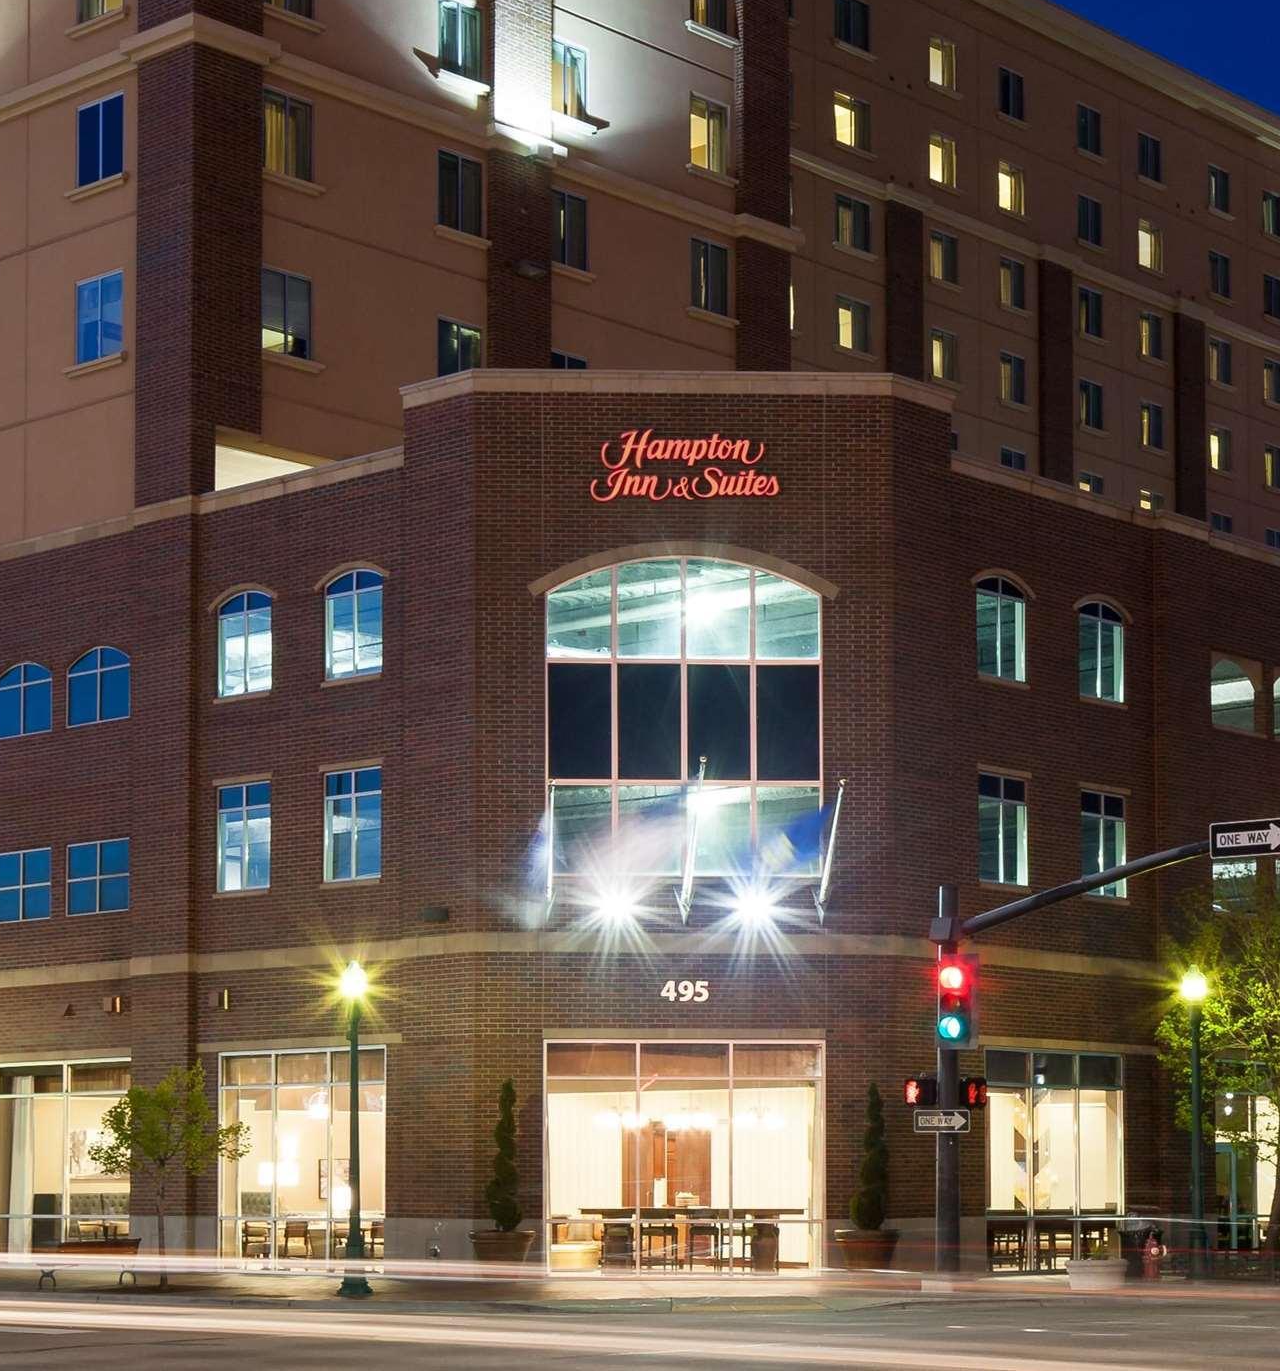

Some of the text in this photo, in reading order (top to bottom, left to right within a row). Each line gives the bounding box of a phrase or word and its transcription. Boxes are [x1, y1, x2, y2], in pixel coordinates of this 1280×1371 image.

[601, 428, 764, 469] Hampton
[590, 467, 780, 501] Inn & Suites
[1220, 831, 1270, 846] ONE WAY
[660, 980, 709, 1002] 495
[920, 1117, 953, 1126] ONE WAY
